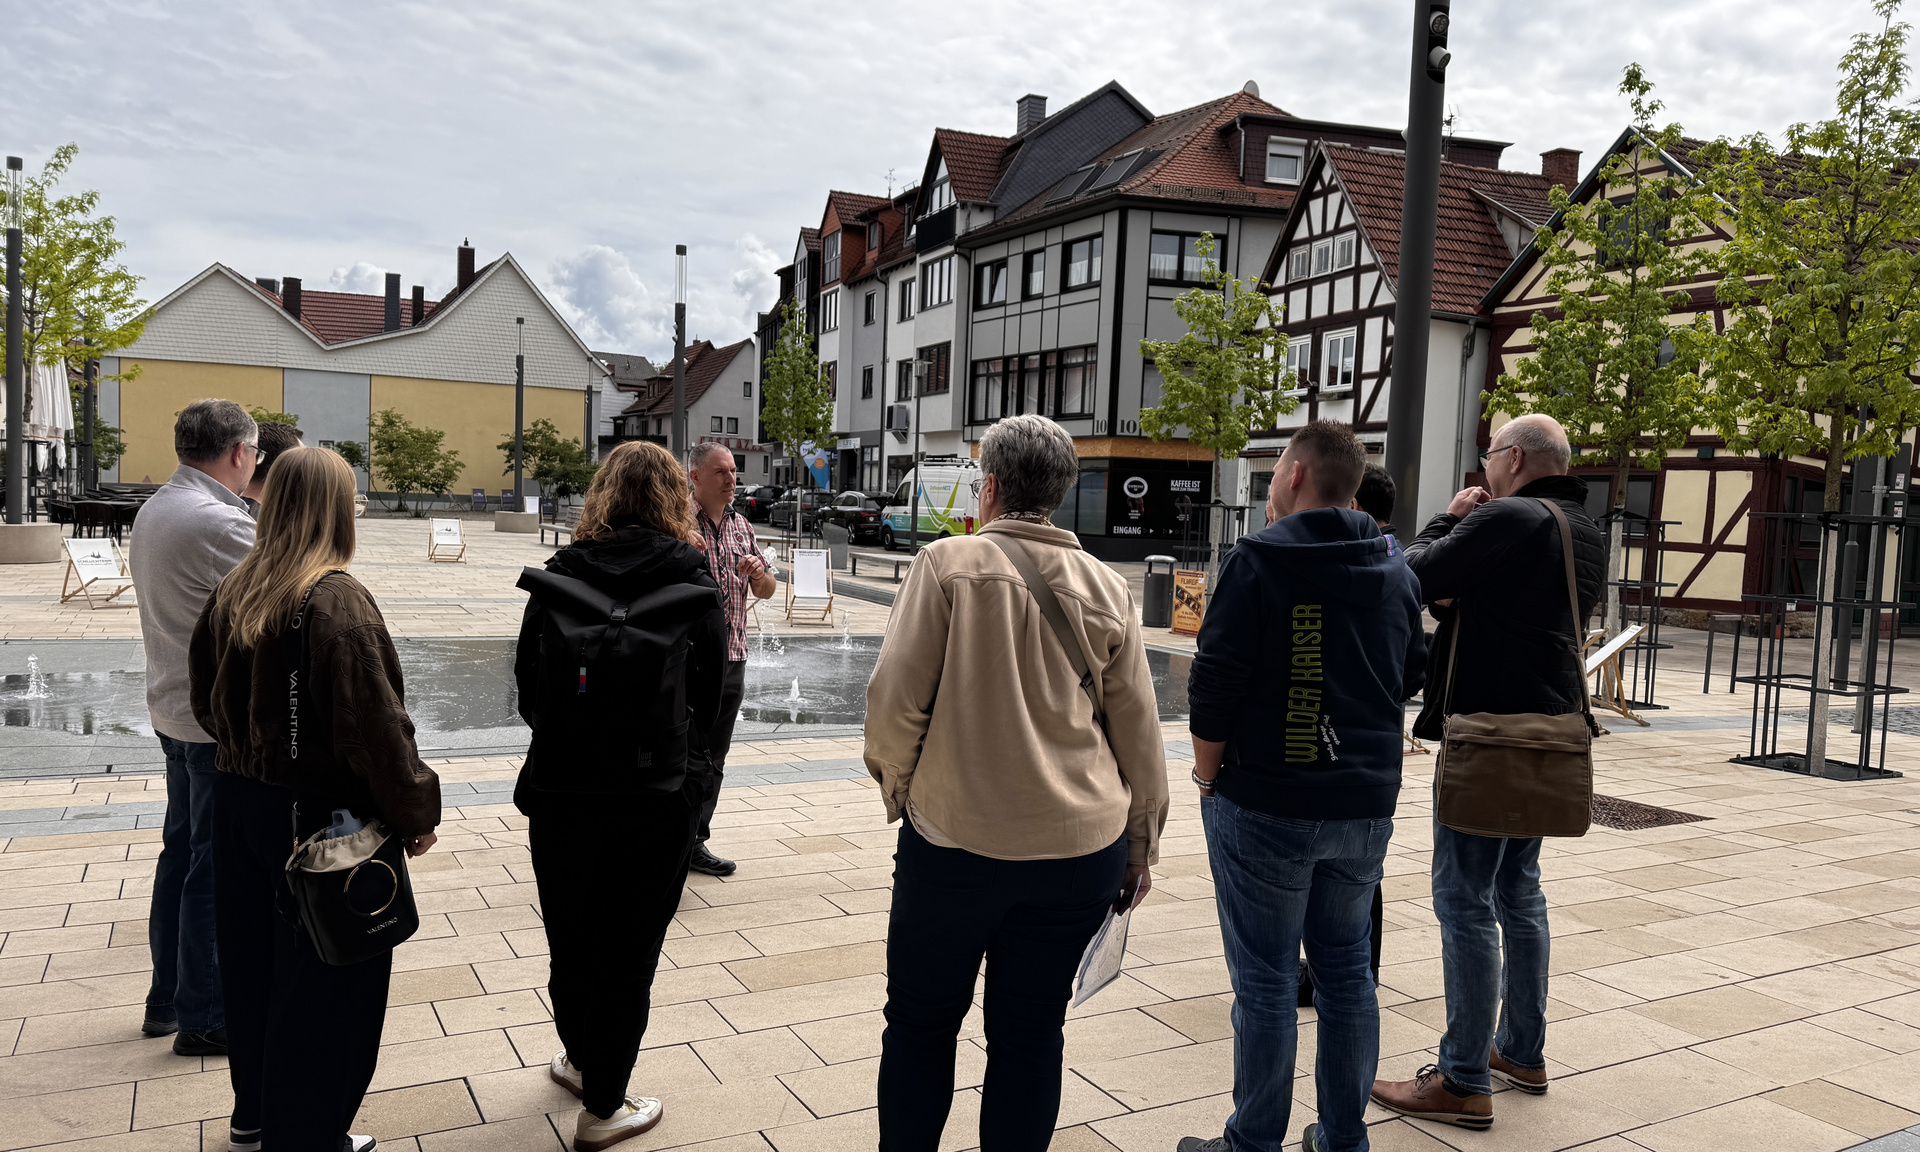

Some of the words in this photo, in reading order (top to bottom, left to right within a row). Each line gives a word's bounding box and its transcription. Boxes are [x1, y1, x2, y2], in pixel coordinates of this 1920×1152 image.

[1095, 419, 1107, 434] 10
[1119, 419, 1137, 434] 10
[1113, 526, 1141, 534] EINGANG
[1290, 604, 1323, 681] KAISER
[289, 670, 299, 759] VALENTINO
[1285, 686, 1322, 762] WILDER
[366, 916, 398, 935] VALENTINO
